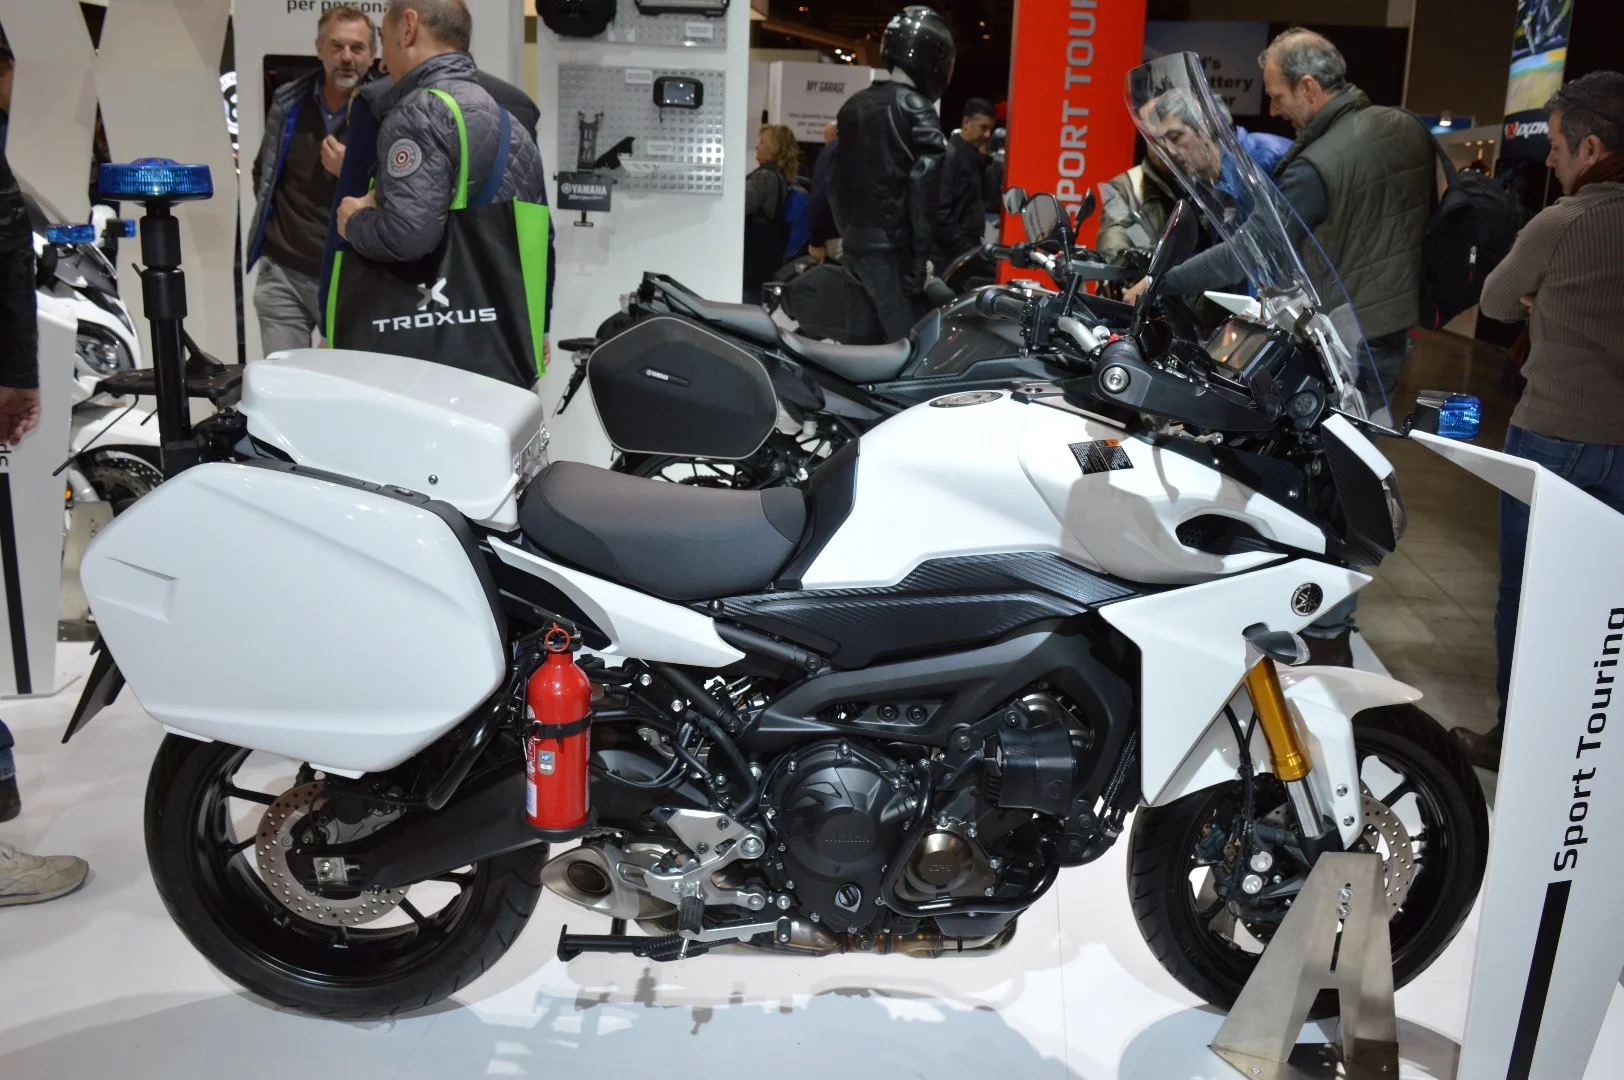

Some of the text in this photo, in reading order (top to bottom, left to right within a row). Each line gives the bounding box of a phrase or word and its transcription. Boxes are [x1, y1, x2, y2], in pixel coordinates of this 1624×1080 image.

[572, 184, 608, 196] YAMAHA
[372, 307, 497, 332] TROXUS
[1553, 766, 1597, 872] Sport
